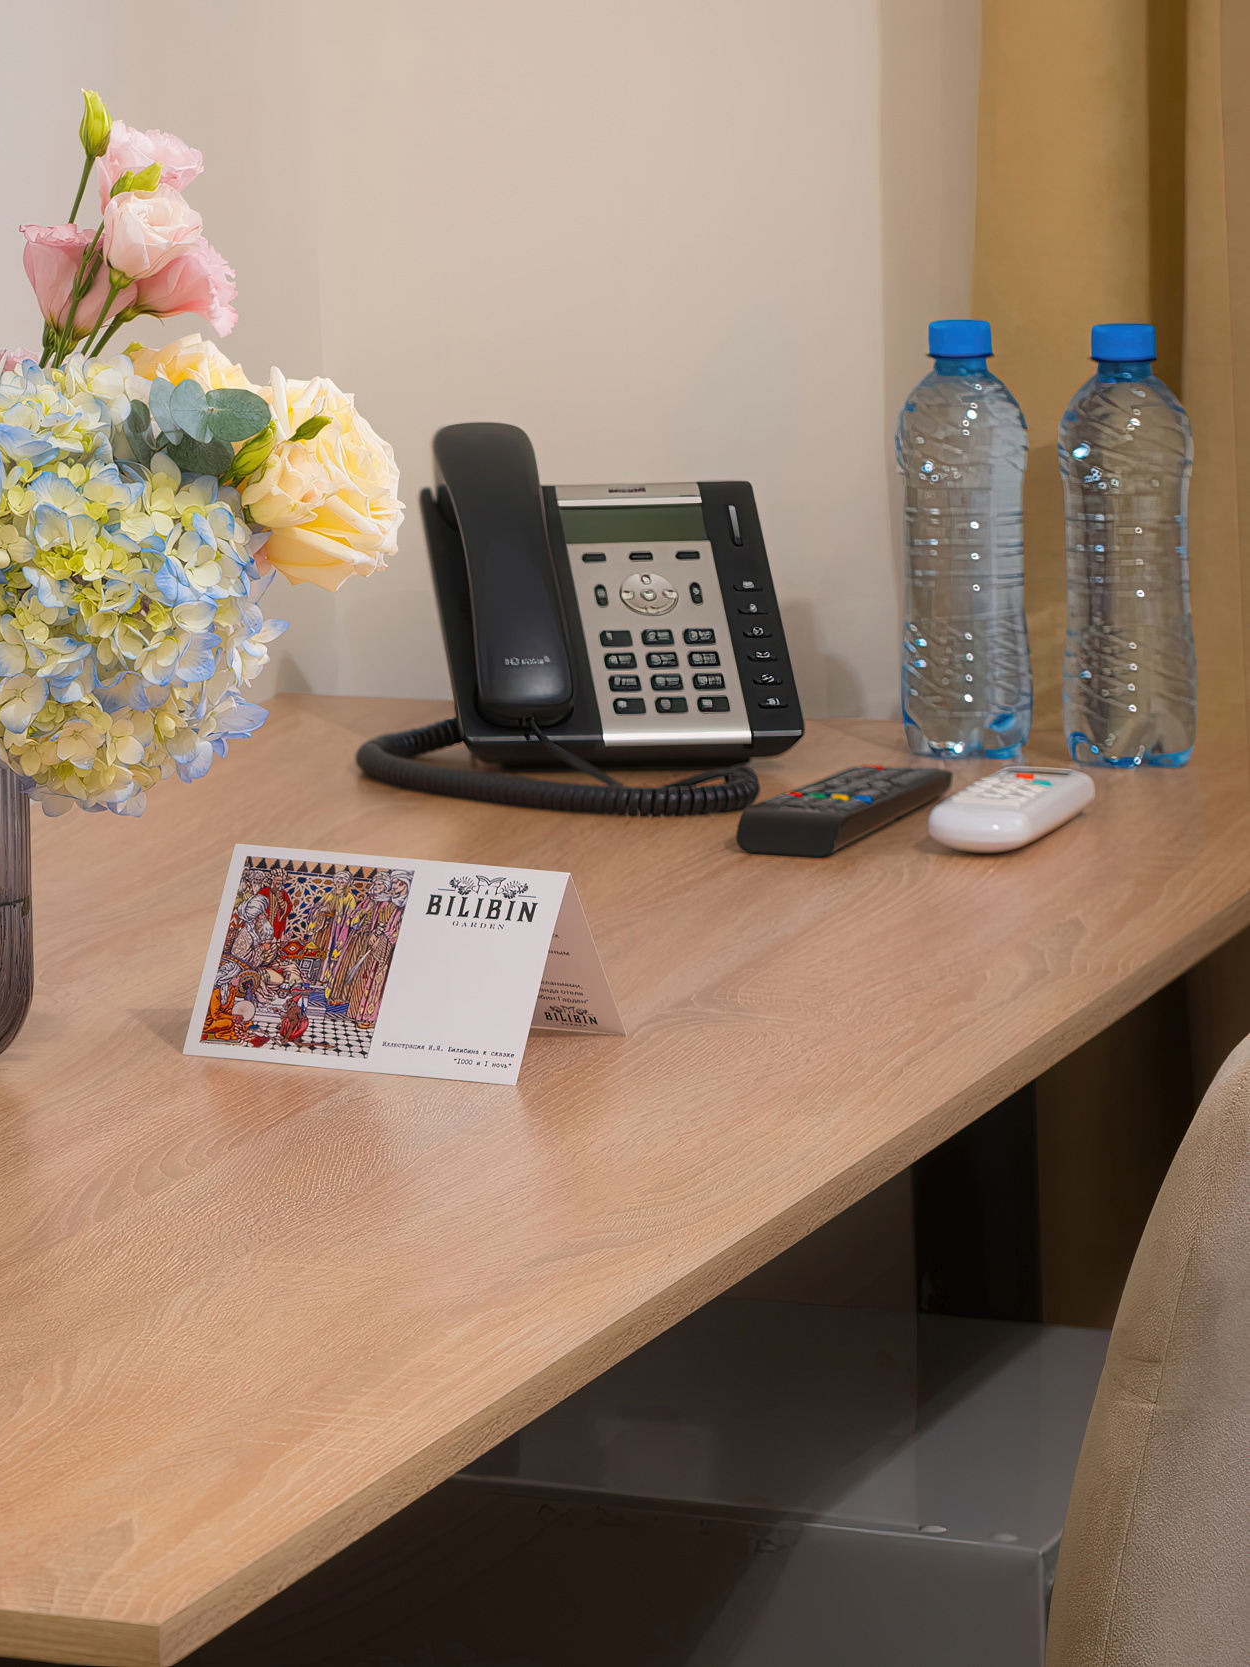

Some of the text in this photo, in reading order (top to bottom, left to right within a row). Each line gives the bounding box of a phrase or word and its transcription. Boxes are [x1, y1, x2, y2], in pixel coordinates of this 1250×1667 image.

[426, 894, 538, 922] BILIBIN
[452, 920, 505, 930] GARDEN
[544, 1011, 598, 1025] BILIBIN
[381, 1040, 425, 1050] Иллюстрация
[448, 1046, 479, 1055] Билибина
